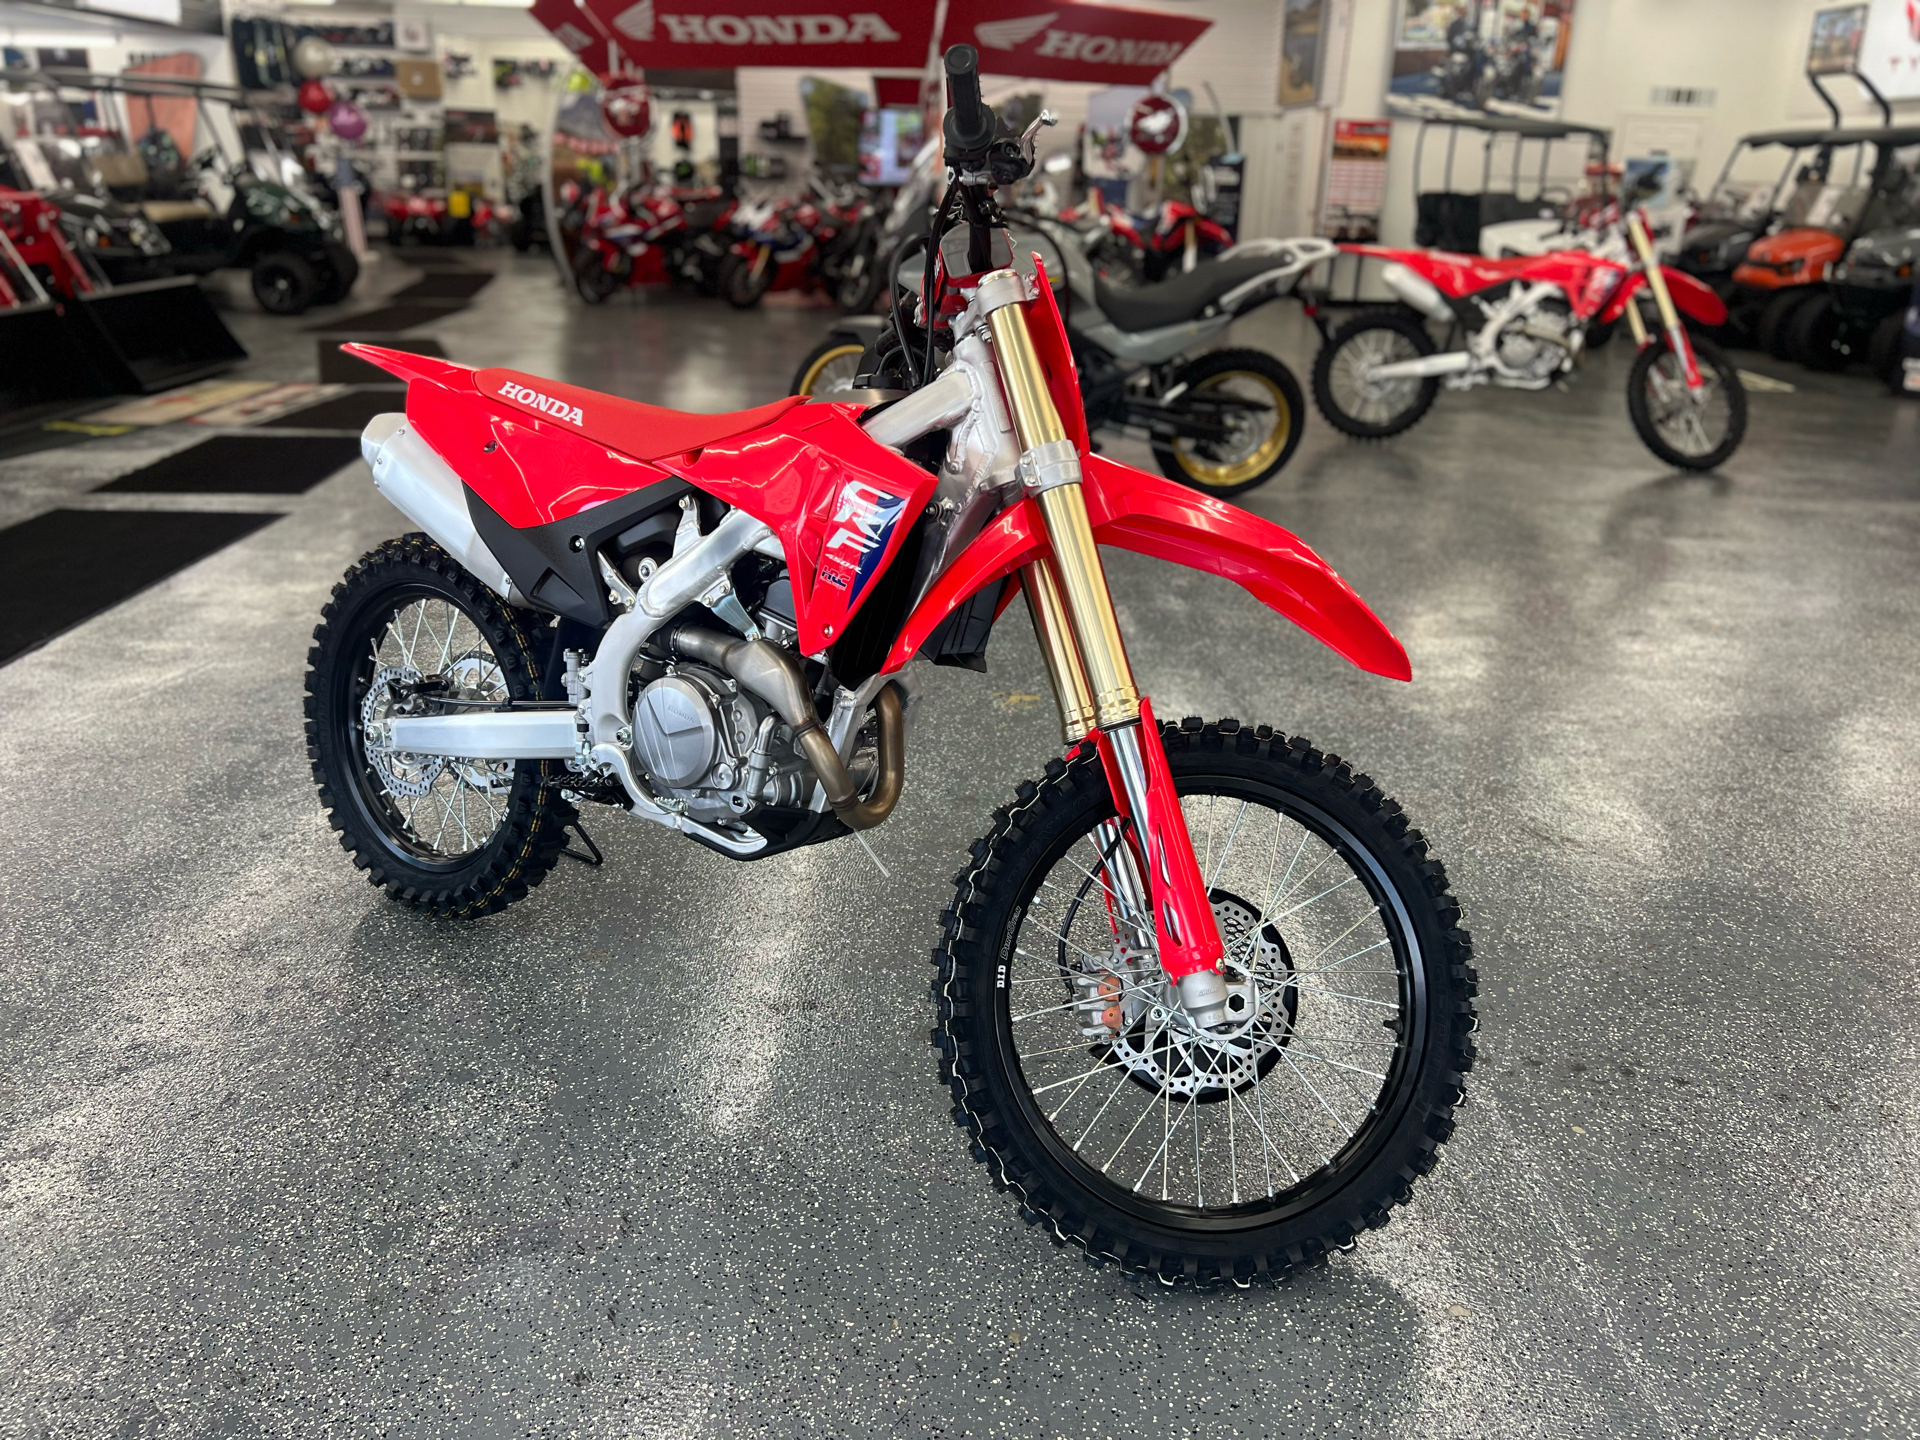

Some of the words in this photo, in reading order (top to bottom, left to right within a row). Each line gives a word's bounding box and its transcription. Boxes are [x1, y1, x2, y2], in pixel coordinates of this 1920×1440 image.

[659, 13, 901, 45] HONDA
[497, 381, 584, 427] HONDA
[826, 480, 894, 554] CRF
[820, 564, 851, 588] HRC
[824, 553, 863, 575] 450R
[667, 704, 696, 724] HONDA
